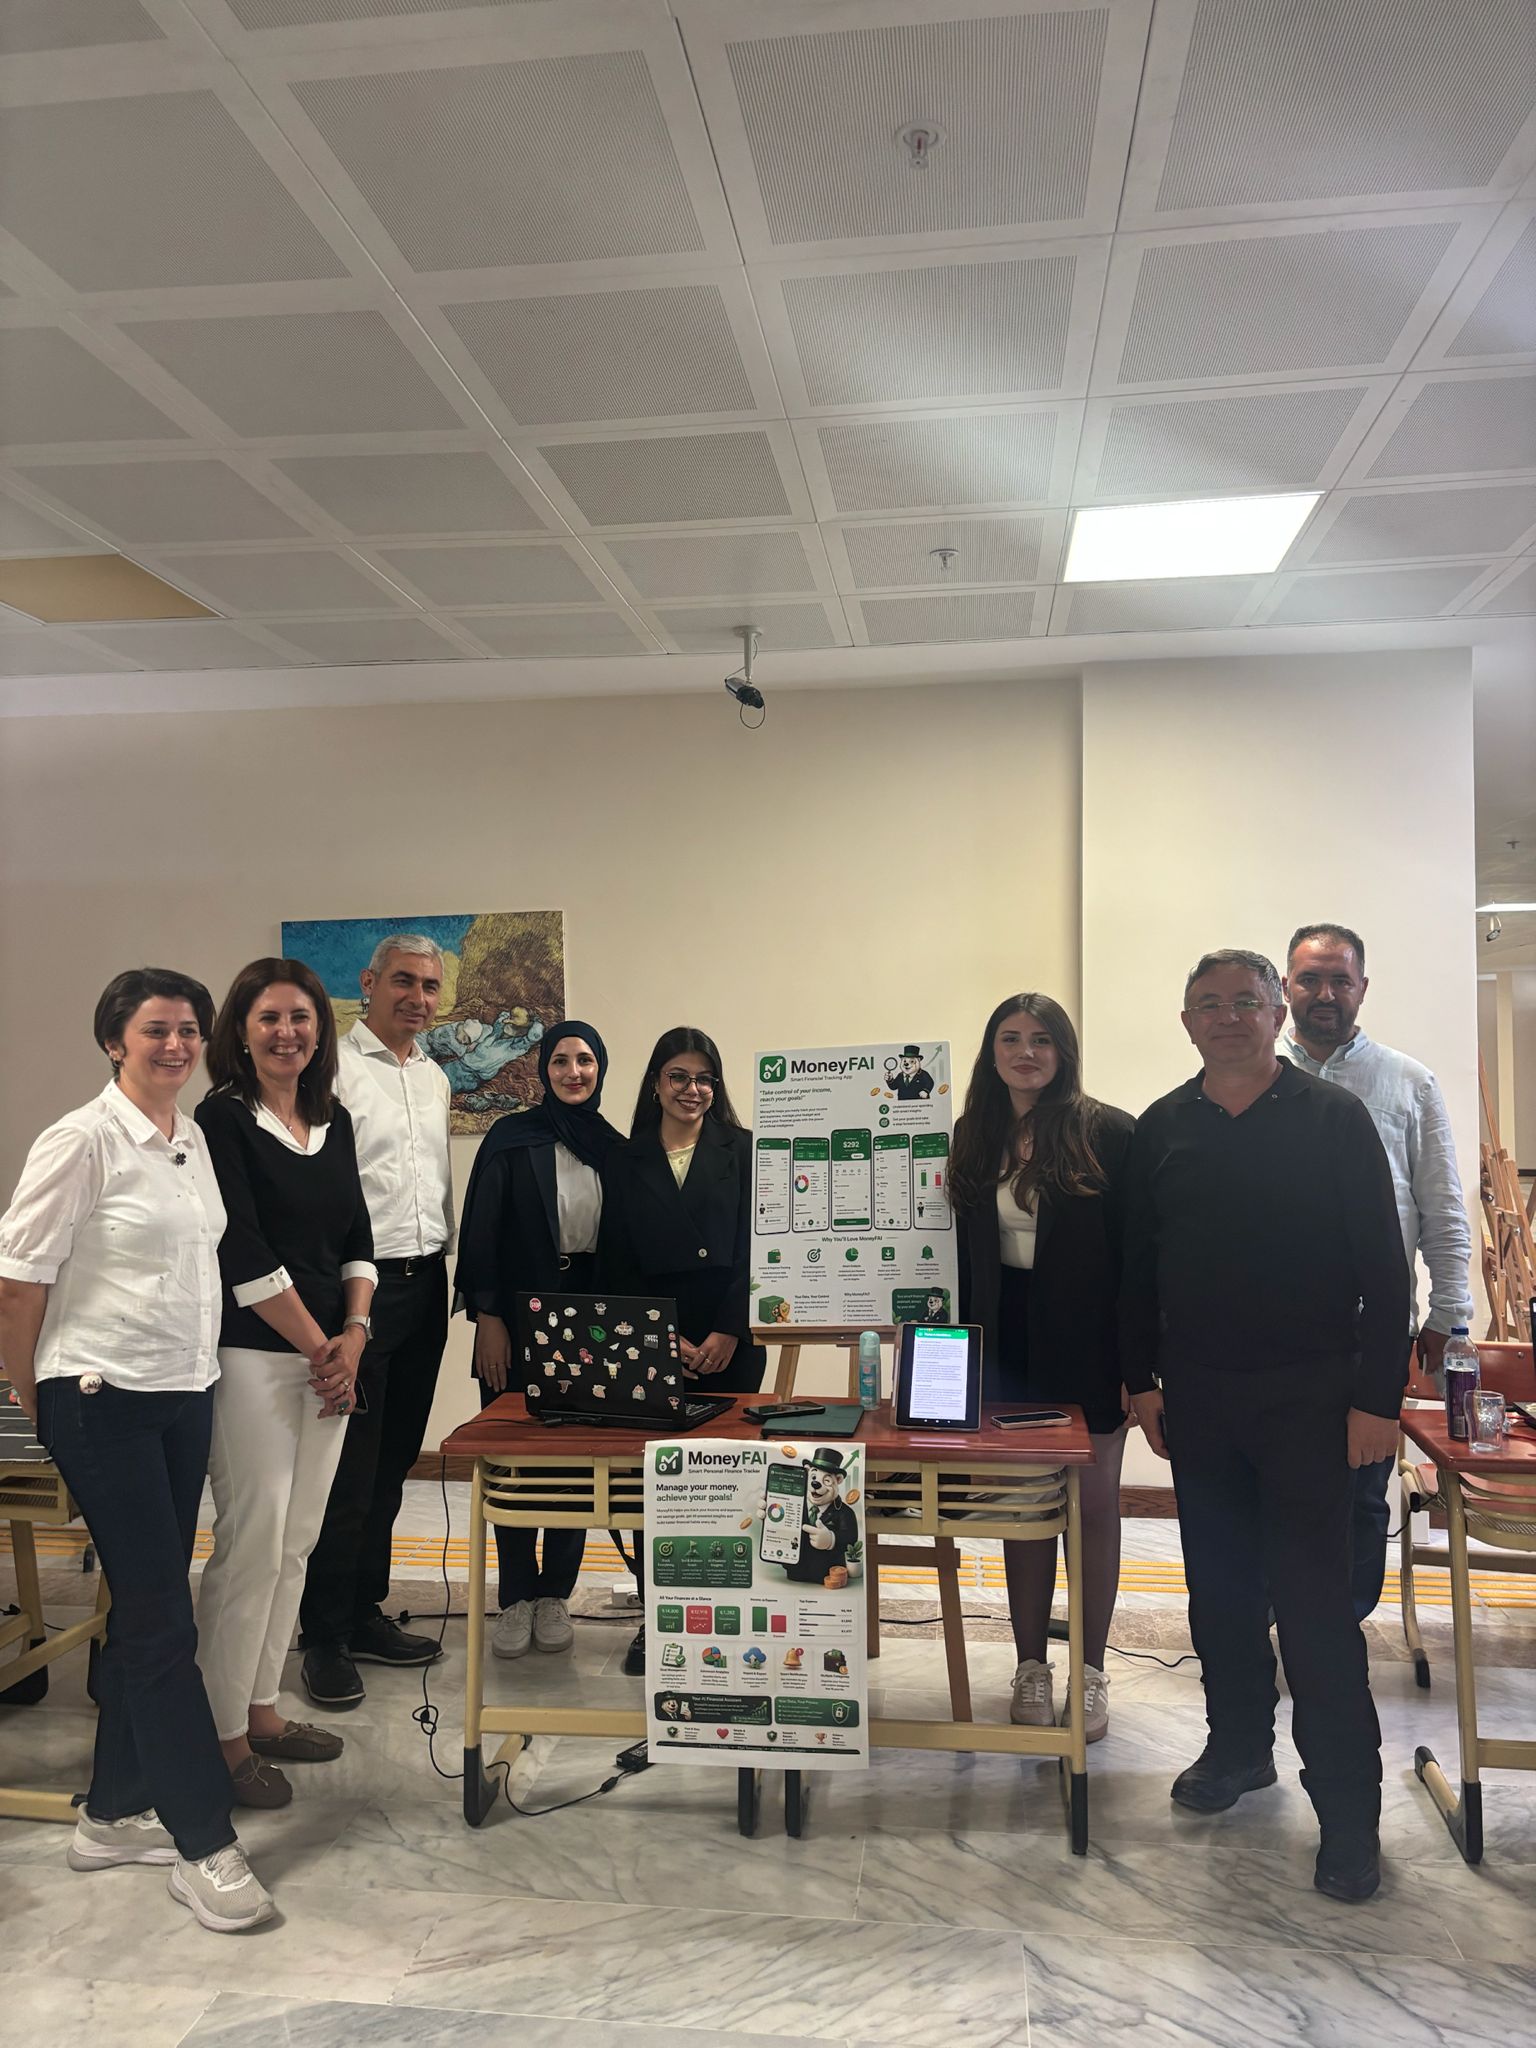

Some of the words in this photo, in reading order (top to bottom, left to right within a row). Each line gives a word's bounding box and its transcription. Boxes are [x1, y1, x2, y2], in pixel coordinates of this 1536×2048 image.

[790, 1056, 875, 1075] MoneyFAI
[688, 1451, 768, 1468] MoneyFAI
[656, 1484, 689, 1493] Manage
[690, 1485, 708, 1493] your
[709, 1484, 739, 1493] money,
[656, 1493, 688, 1502] achieve
[689, 1494, 708, 1503] your
[709, 1493, 733, 1503] goals!
